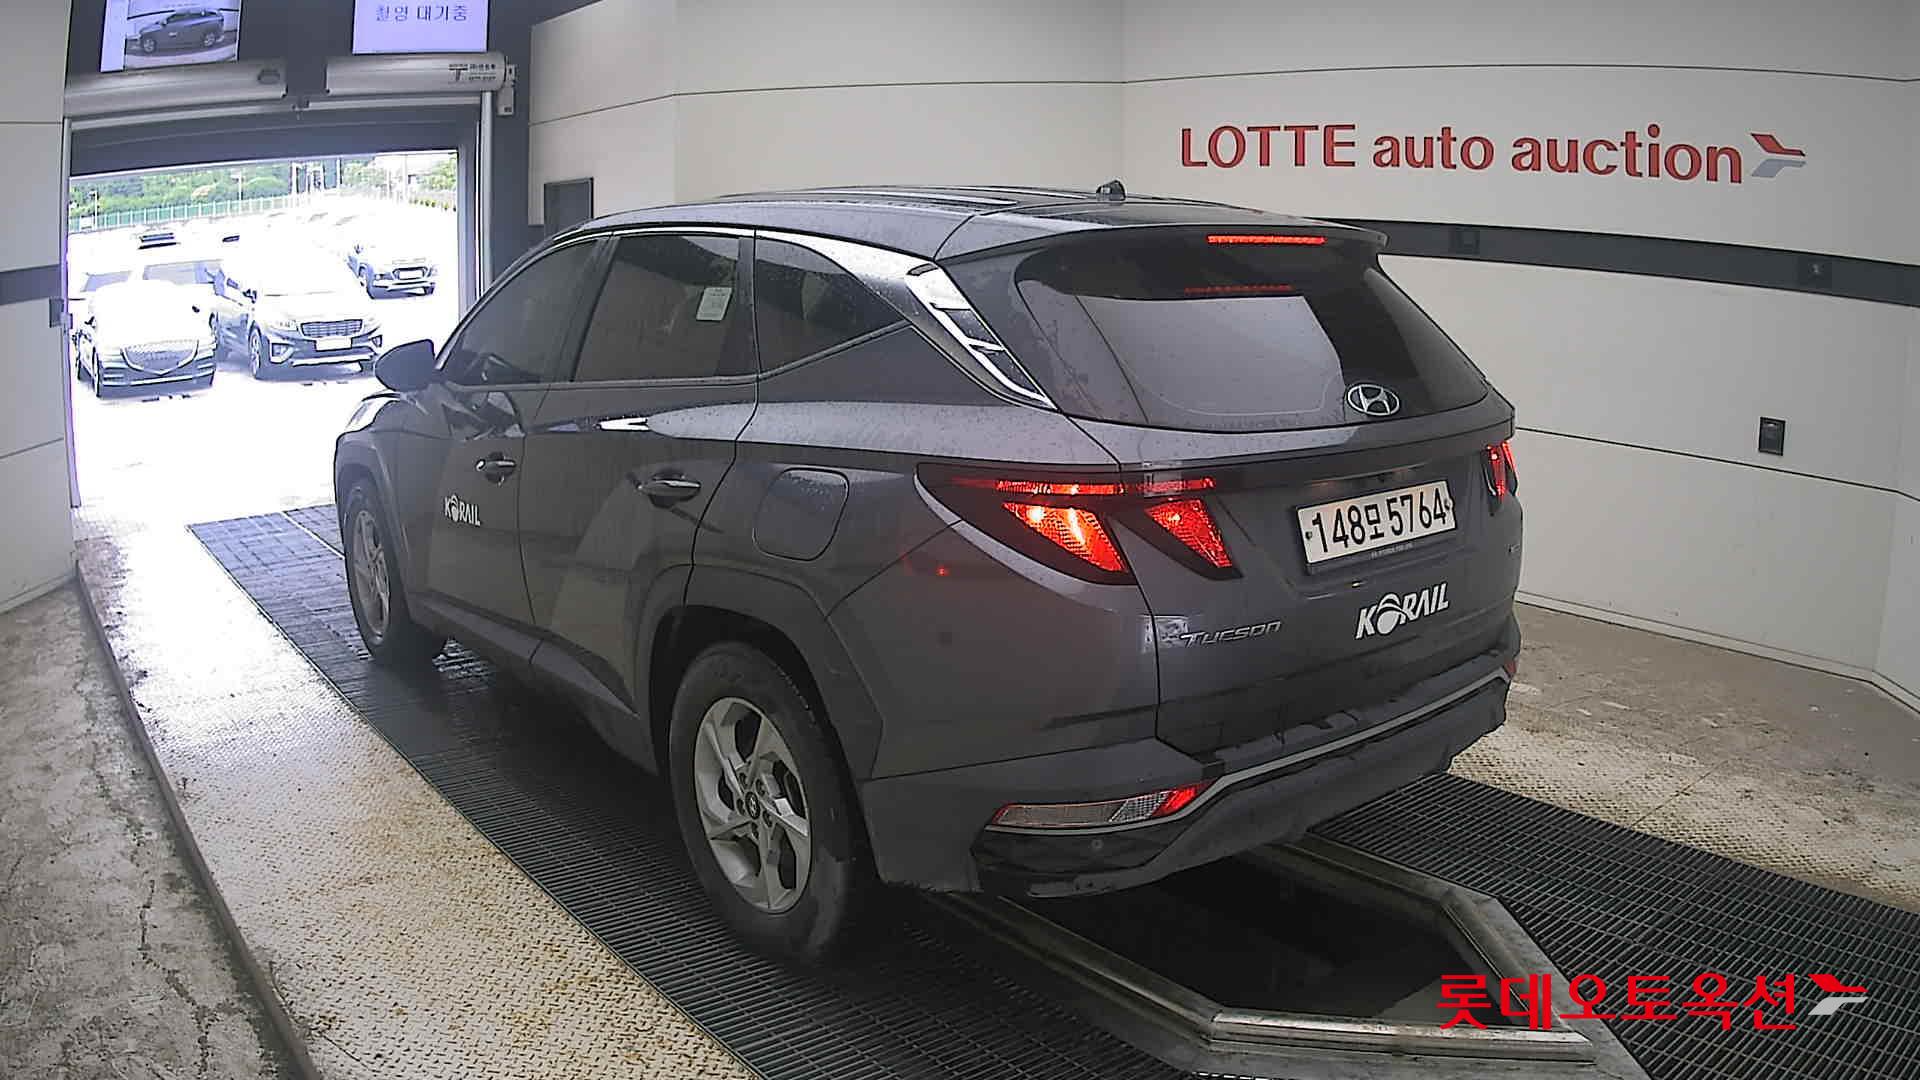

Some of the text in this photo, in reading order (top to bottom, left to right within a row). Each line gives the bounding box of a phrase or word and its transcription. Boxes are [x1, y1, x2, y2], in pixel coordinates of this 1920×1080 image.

[417, 4, 467, 21] 대기중
[1180, 123, 1743, 184] LOTTE auto auction
[443, 494, 481, 527] KORAIL
[1355, 582, 1449, 639] KORAIL
